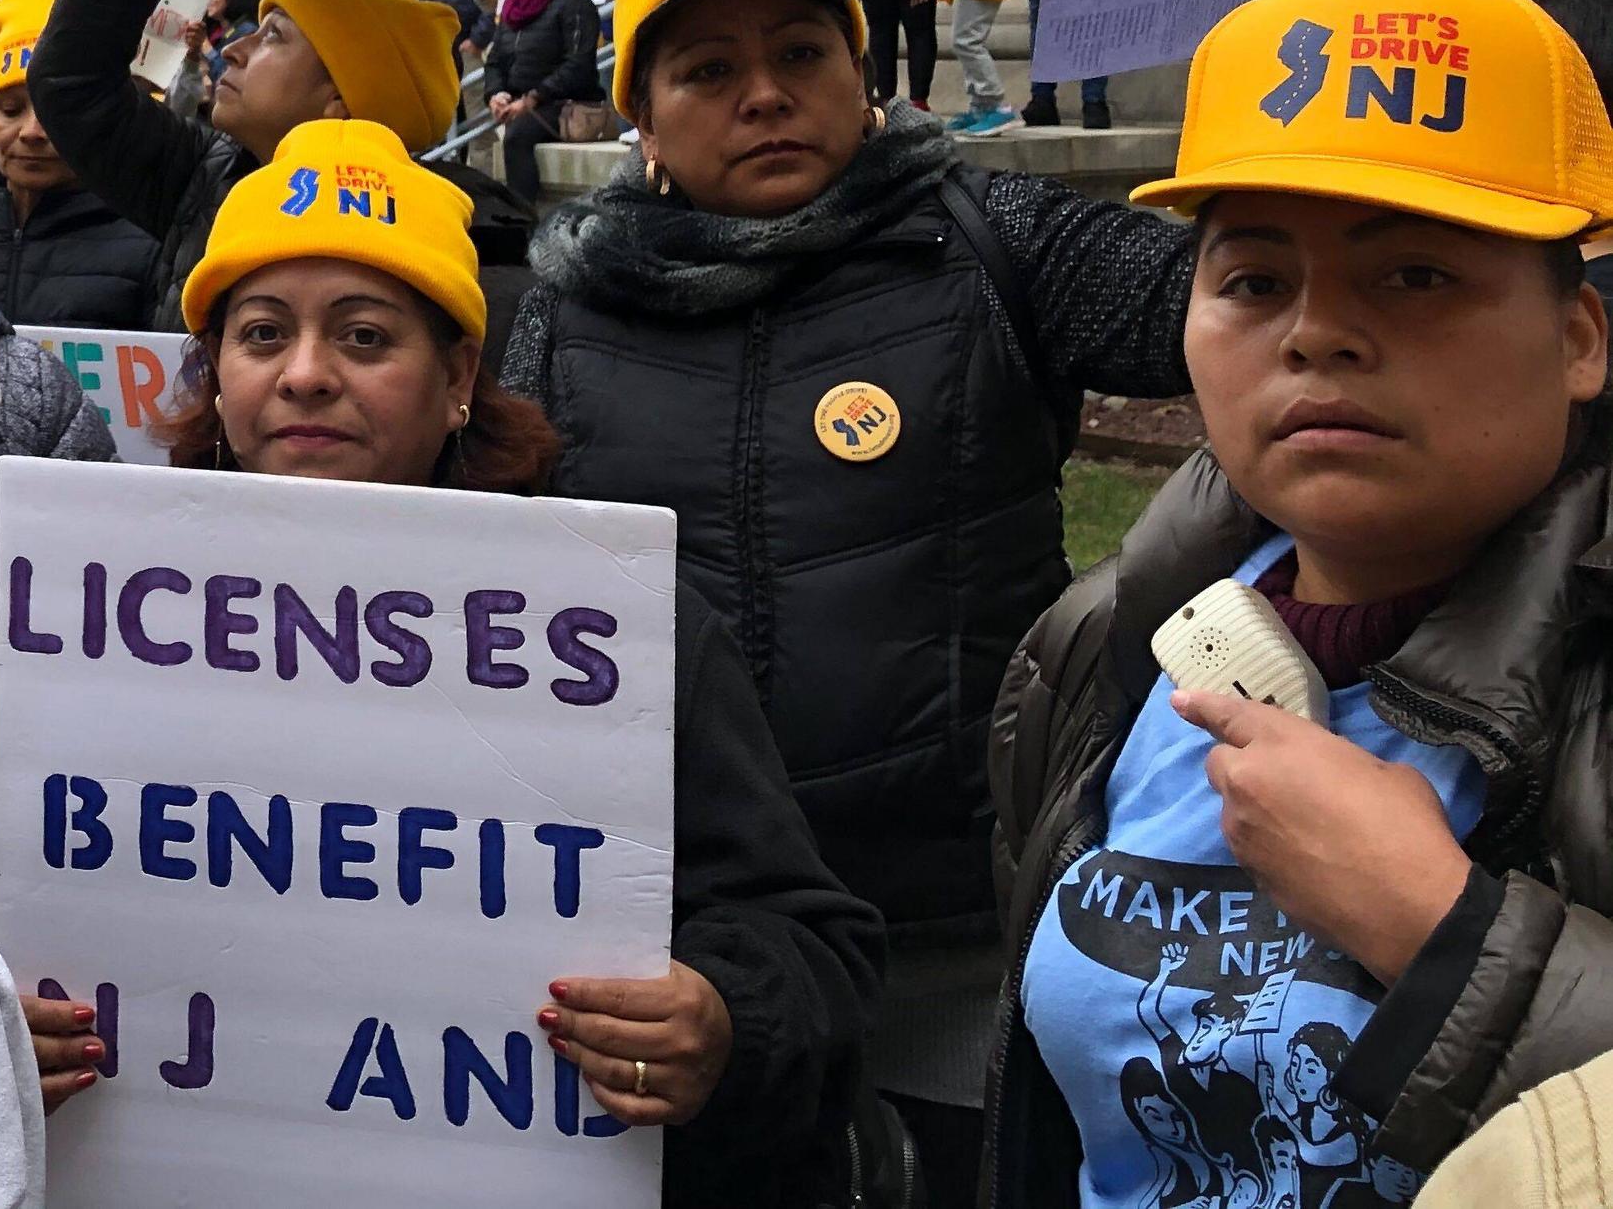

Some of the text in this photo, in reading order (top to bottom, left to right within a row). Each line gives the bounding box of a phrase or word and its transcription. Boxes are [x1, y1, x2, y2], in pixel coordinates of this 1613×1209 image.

[1353, 13, 1460, 41] LET'S
[1350, 38, 1470, 71] DRIVE
[1345, 65, 1467, 133] NJ
[335, 165, 387, 183] LET'S
[336, 175, 395, 196] DRIVE
[338, 187, 397, 225] NJ
[856, 404, 887, 435] NJ
[8, 556, 620, 706] LICENSES
[43, 773, 605, 919] BENEFIT
[1080, 868, 1254, 936] MAKE
[1219, 931, 1315, 977] NEW
